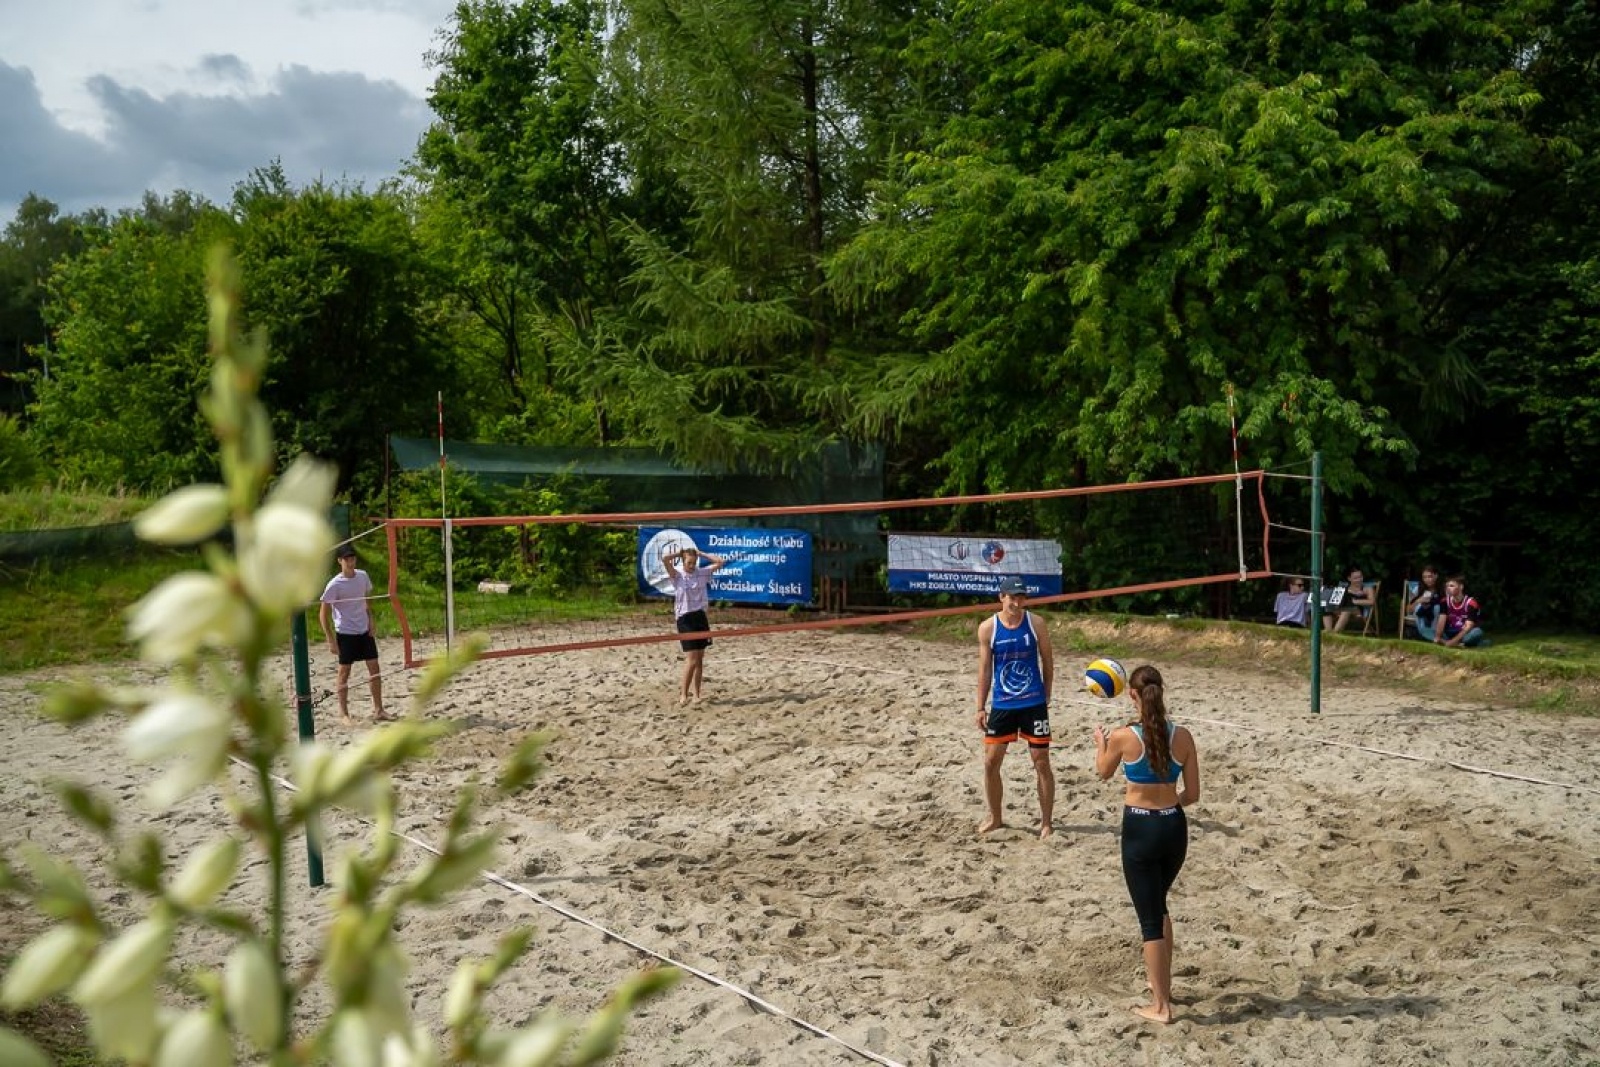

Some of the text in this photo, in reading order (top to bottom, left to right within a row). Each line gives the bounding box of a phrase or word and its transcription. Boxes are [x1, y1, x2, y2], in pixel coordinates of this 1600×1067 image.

[708, 534, 804, 548] Działalność klubu
[928, 572, 960, 581] MIASTO
[709, 578, 802, 597] Wodzisław Śląski
[1023, 633, 1030, 646] 1
[1033, 720, 1050, 736] 26
